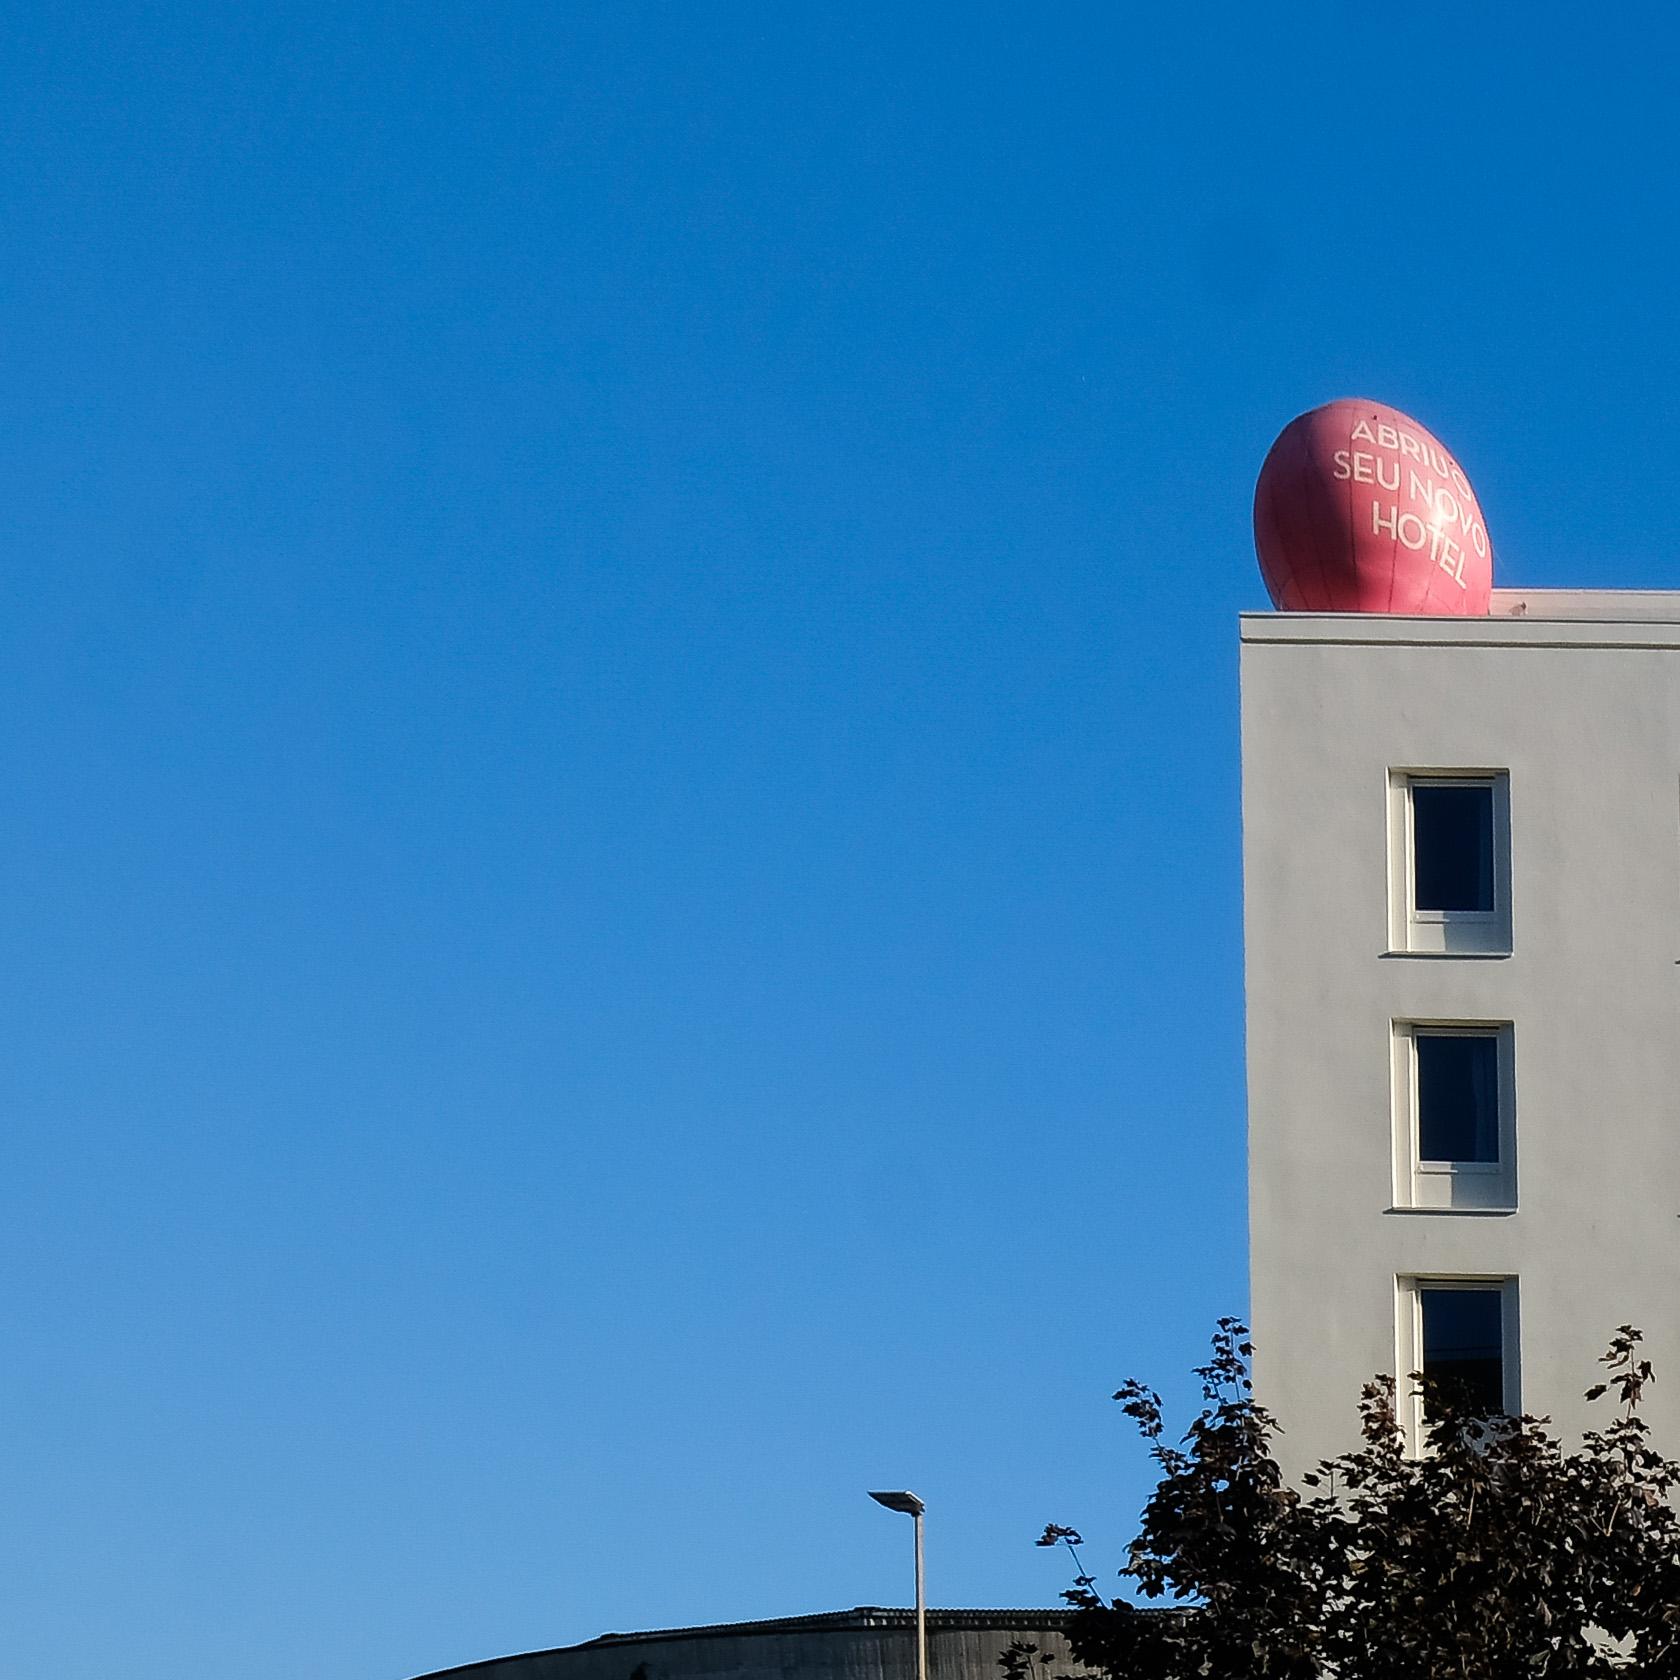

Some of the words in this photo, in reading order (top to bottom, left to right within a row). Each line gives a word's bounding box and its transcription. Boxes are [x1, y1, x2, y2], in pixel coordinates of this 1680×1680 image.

[1351, 420, 1449, 478] ABRIU
[1333, 450, 1401, 490] SEU
[1410, 469, 1488, 559] NOVO
[1371, 500, 1467, 589] HOTEL
